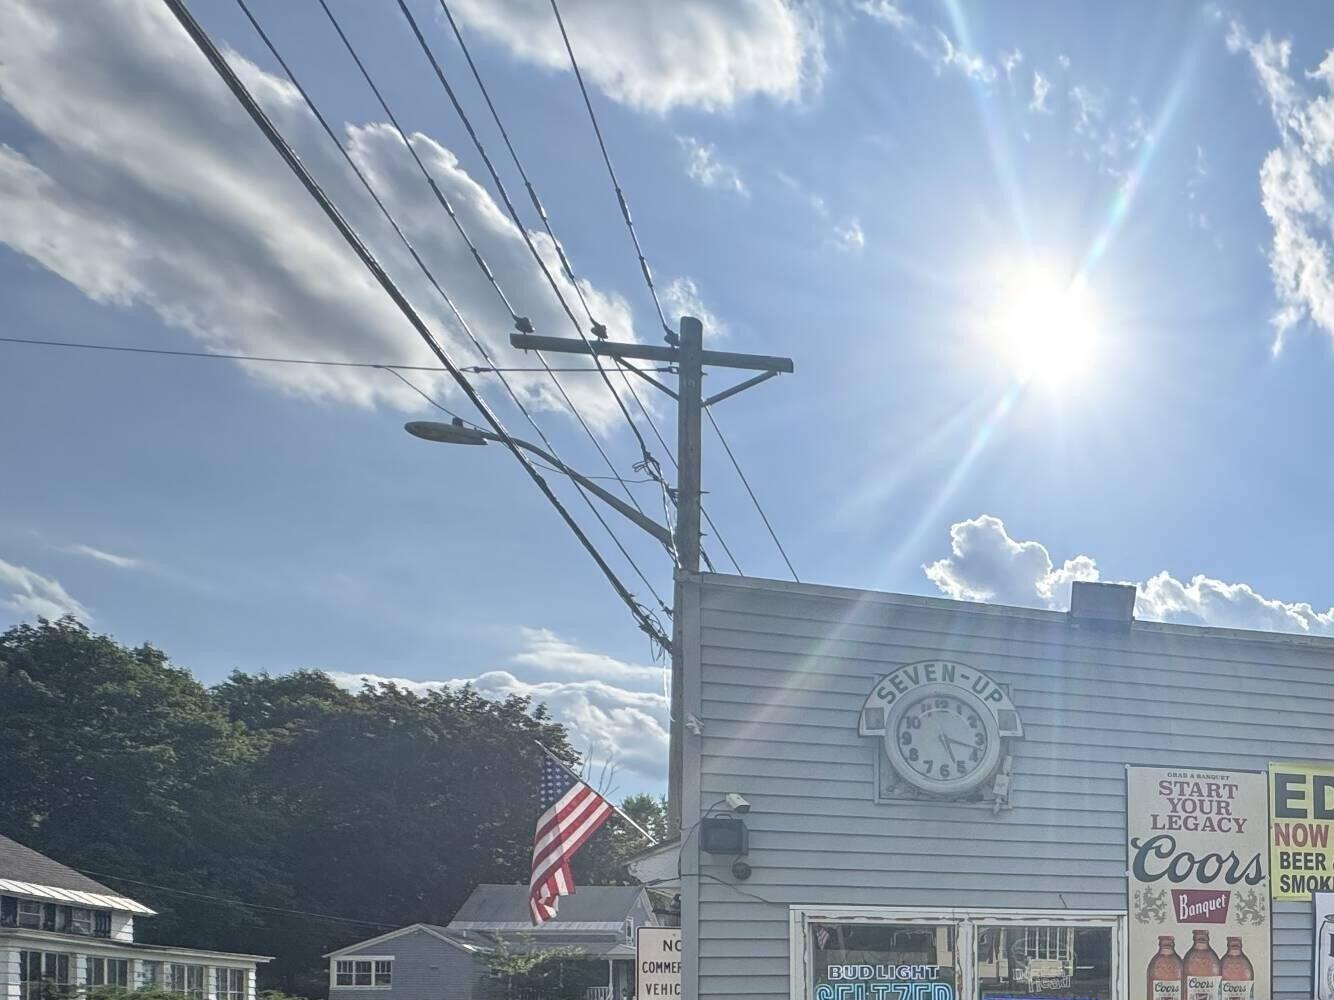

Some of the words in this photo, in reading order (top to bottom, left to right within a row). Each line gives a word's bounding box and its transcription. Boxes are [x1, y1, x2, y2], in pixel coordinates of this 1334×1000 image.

[876, 662, 1003, 705] SEVEN-UP
[906, 715, 921, 730] 10
[901, 731, 912, 746] 9
[974, 732, 985, 747] 3
[923, 759, 933, 774] 7
[939, 764, 950, 778] 6
[1158, 780, 1239, 800] START
[1167, 798, 1232, 816] YOUR
[1150, 814, 1248, 834] LEGACY
[1274, 823, 1329, 848] NOW
[1130, 834, 1266, 886] Coors
[1279, 851, 1326, 871] BEER
[1178, 893, 1228, 920] Banquet
[642, 961, 681, 974] COMMER
[827, 965, 875, 980] BUD
[876, 965, 939, 980] LIGHT
[645, 983, 681, 996] VEHIC
[1154, 982, 1180, 993] Coors
[1188, 978, 1214, 989] Coors
[1222, 982, 1247, 993] Coors
